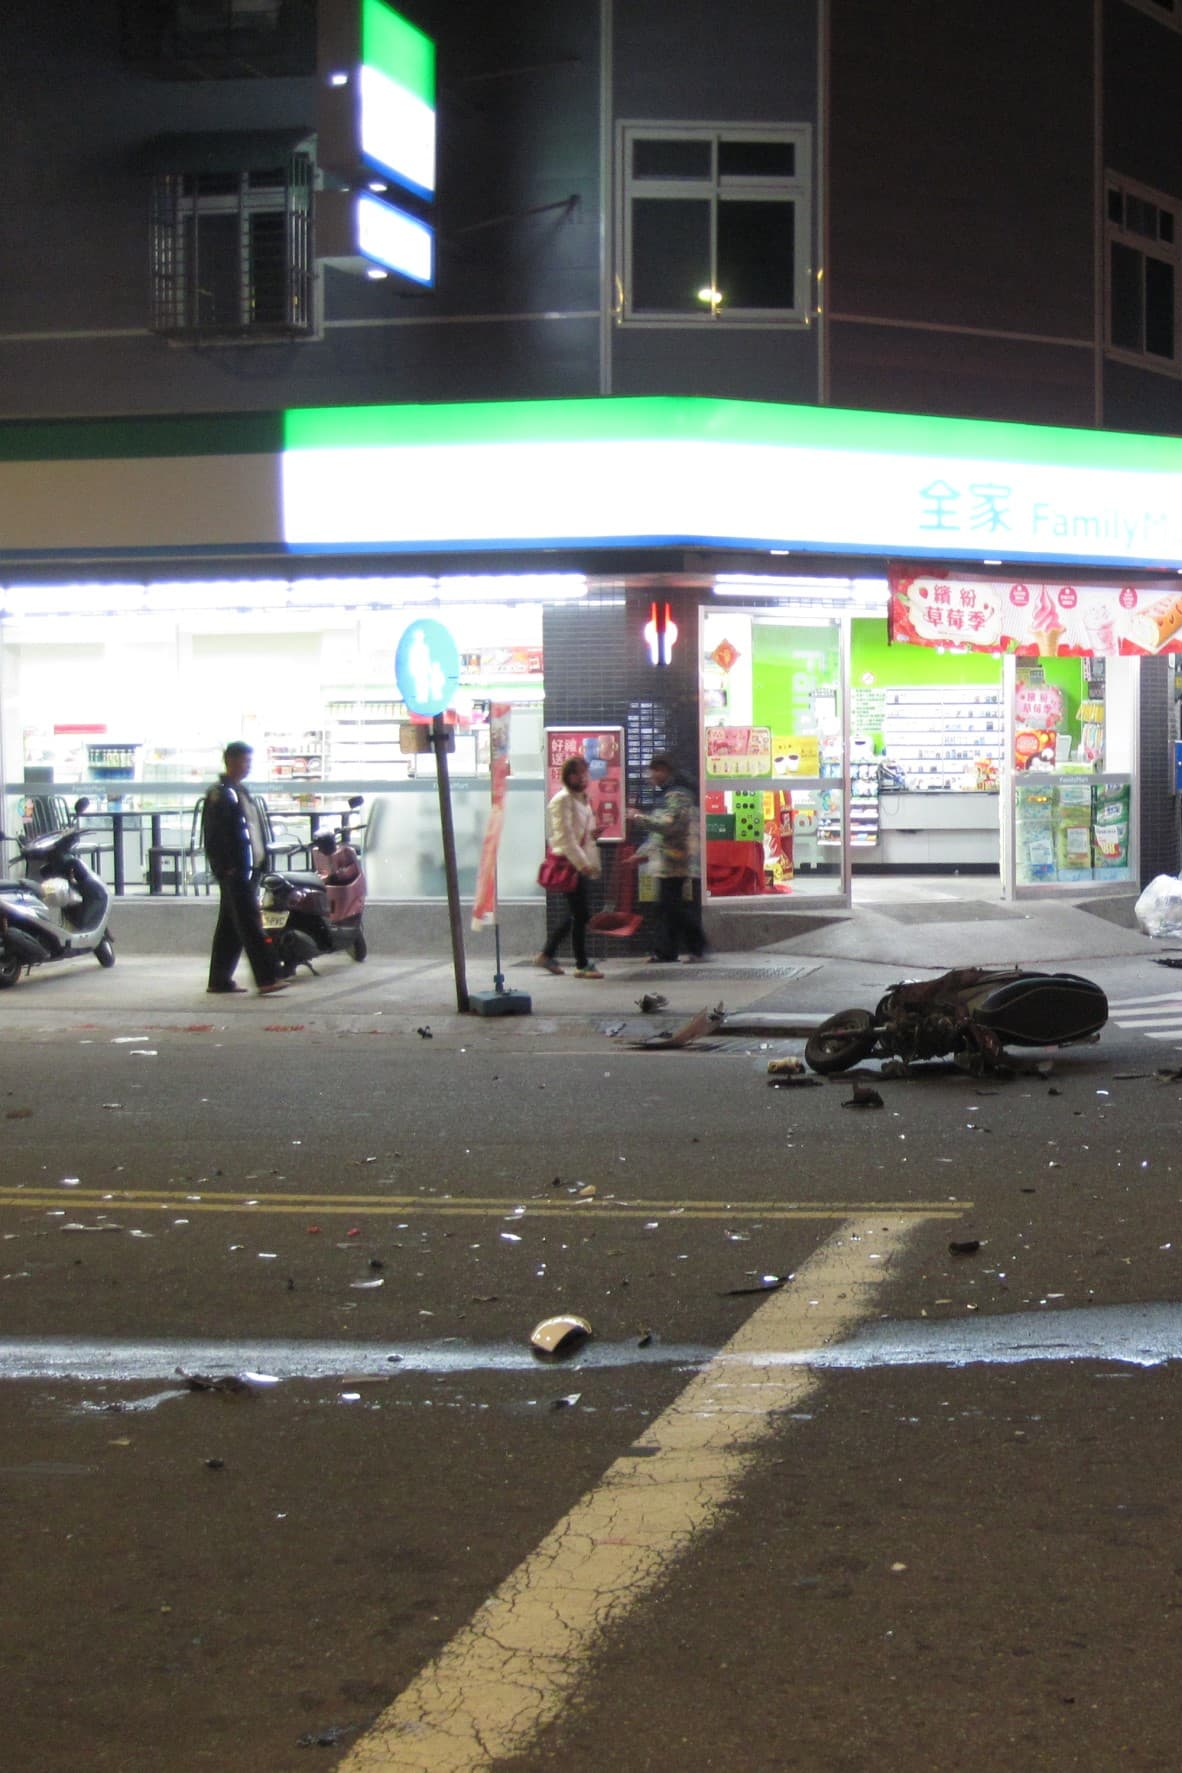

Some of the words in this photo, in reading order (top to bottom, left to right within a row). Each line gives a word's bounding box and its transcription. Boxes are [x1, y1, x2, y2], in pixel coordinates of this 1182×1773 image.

[917, 479, 1015, 534] 全家
[926, 606, 986, 632] 草莓季
